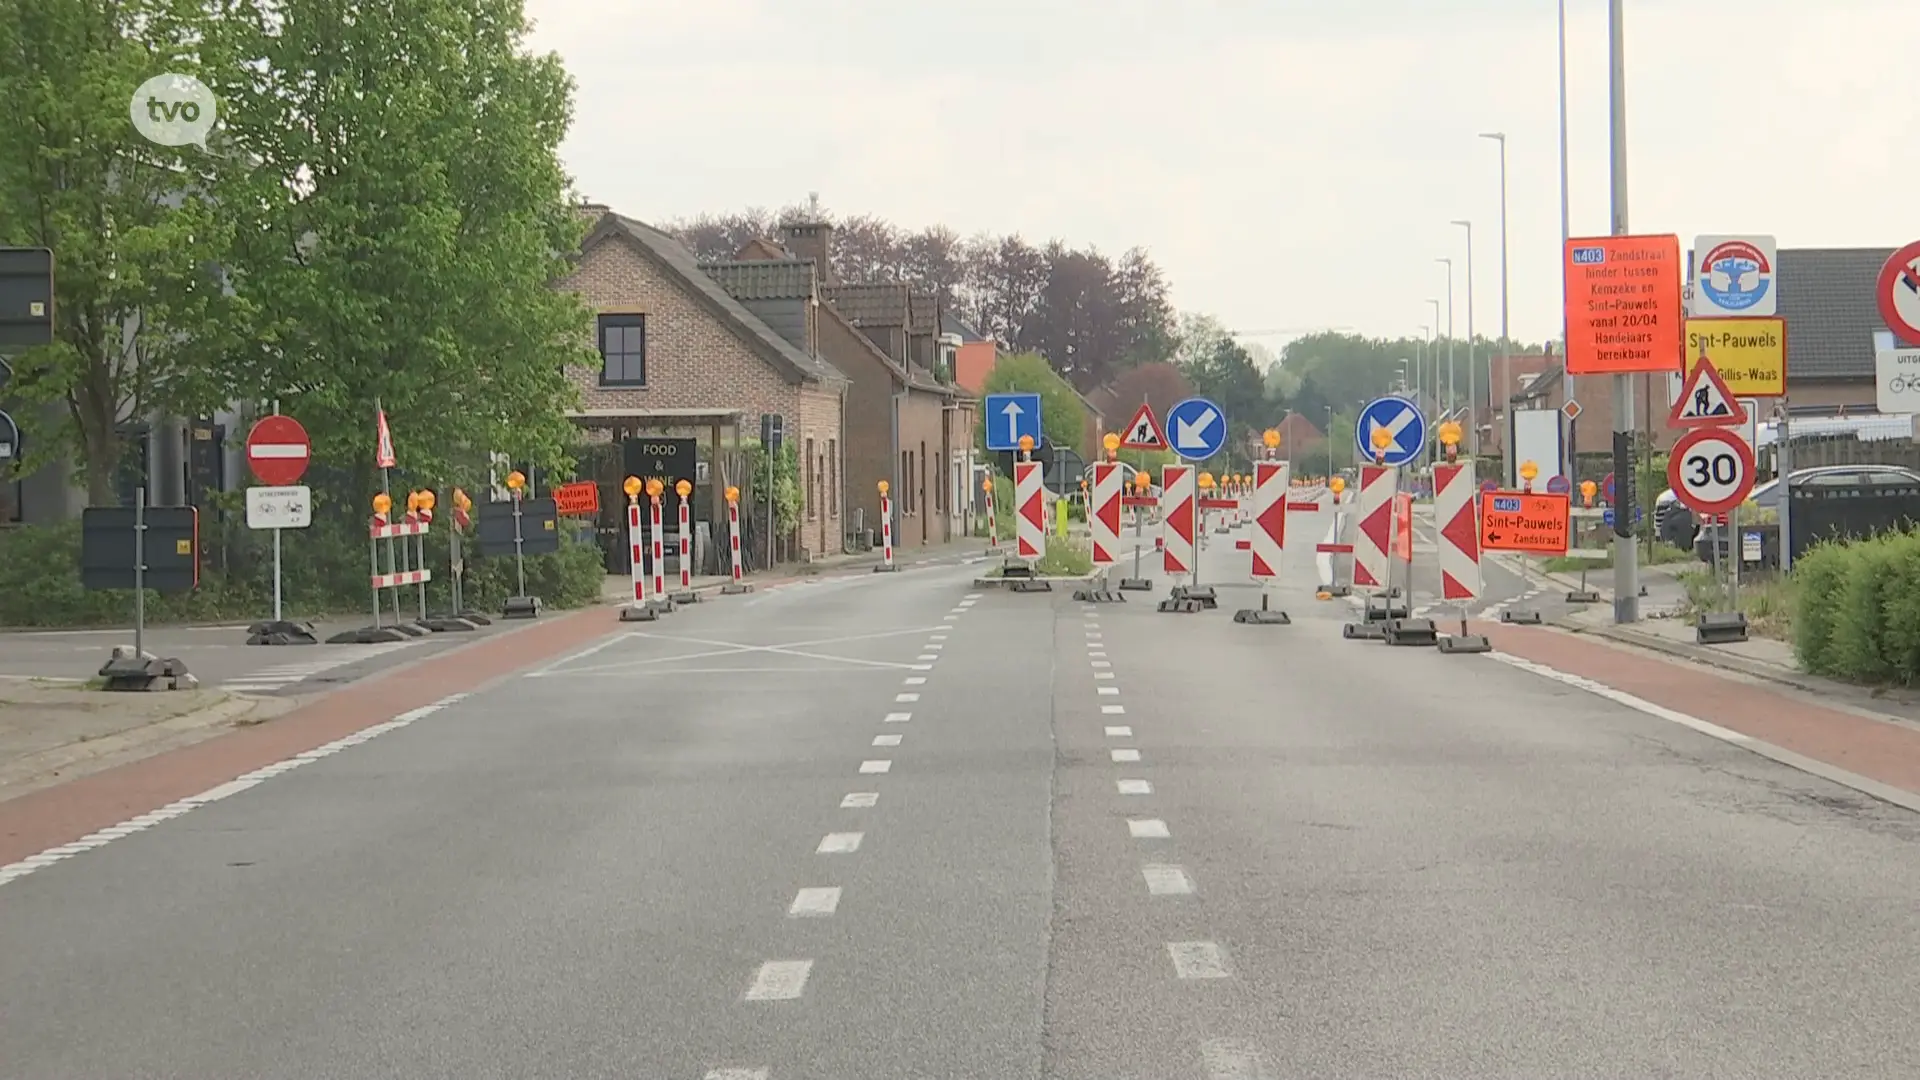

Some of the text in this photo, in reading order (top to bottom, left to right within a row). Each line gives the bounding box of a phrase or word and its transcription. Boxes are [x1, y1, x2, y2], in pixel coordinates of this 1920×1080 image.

[1574, 249, 1602, 261] N403
[1585, 266, 1658, 279] hinder tussen
[1591, 283, 1654, 295] Kemzeke en
[1588, 299, 1658, 311] Sint-Pauwels
[1589, 314, 1657, 327] vanaf 20/04
[1595, 332, 1652, 344] Handelaars
[1597, 349, 1651, 360] bereikbaar
[1897, 355, 1920, 364] UITG
[1690, 368, 1777, 381] Gillis-Waas
[643, 444, 677, 456] FOOD
[655, 460, 664, 471] &
[1687, 453, 1737, 488] 30
[1495, 500, 1519, 511] N403
[1487, 514, 1563, 530] Sint-Pauwels
[1513, 533, 1560, 545] Zandstraat
